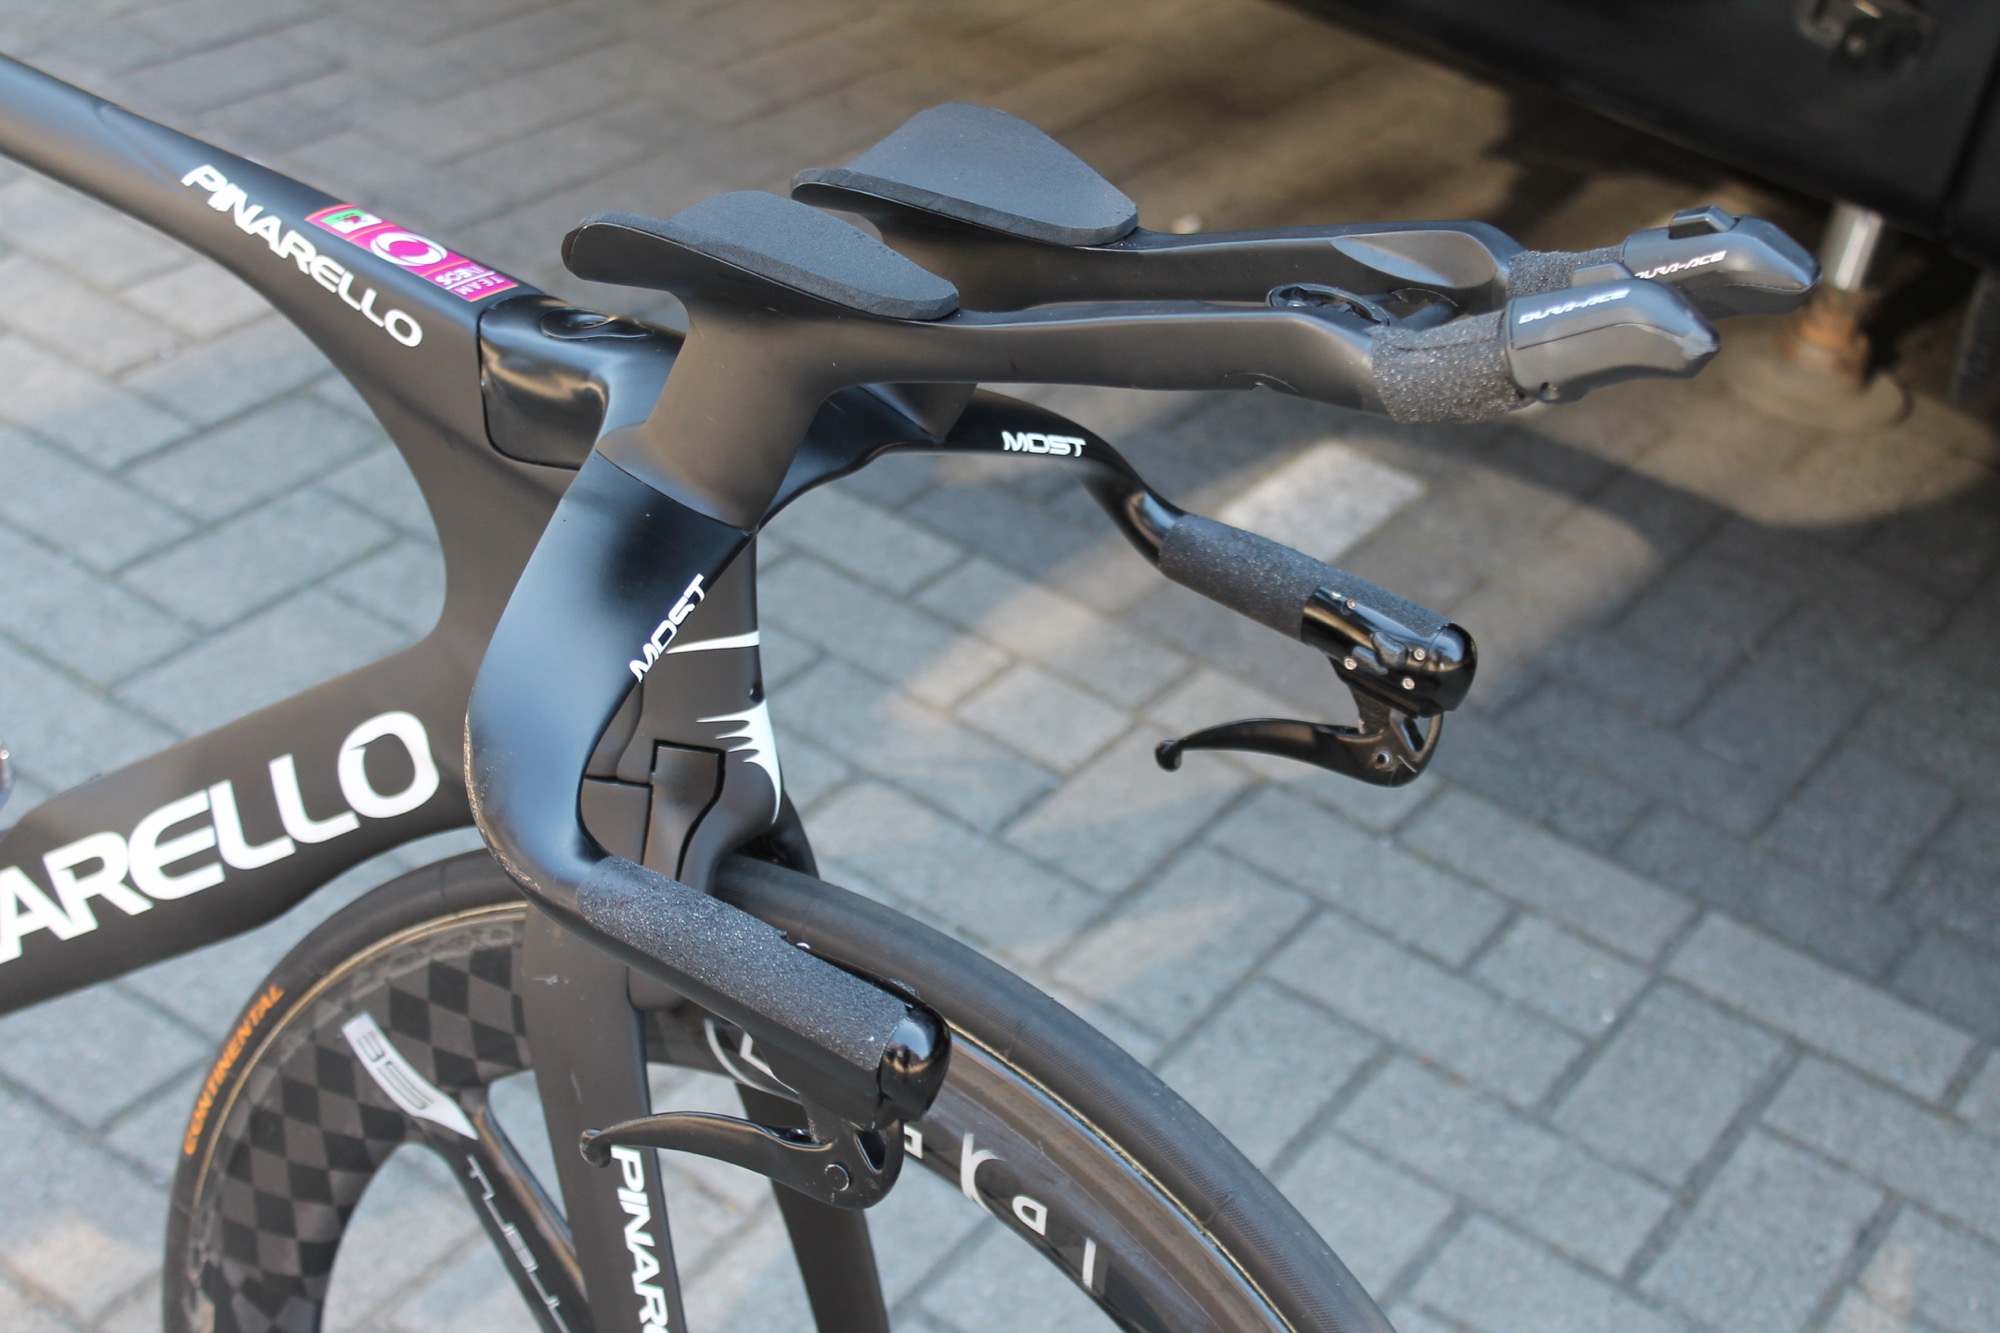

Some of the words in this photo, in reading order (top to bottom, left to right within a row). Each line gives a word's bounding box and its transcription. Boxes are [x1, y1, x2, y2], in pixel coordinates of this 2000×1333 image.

[180, 165, 423, 347] PINARELLO
[435, 265, 485, 286] INEOS
[454, 275, 504, 296] TEAM
[1518, 287, 1631, 325] DURA-ACE
[1001, 430, 1087, 457] MOST
[629, 573, 705, 683] MOST
[0, 711, 440, 965] ARELLO
[184, 984, 284, 1156] CONTINENTAL
